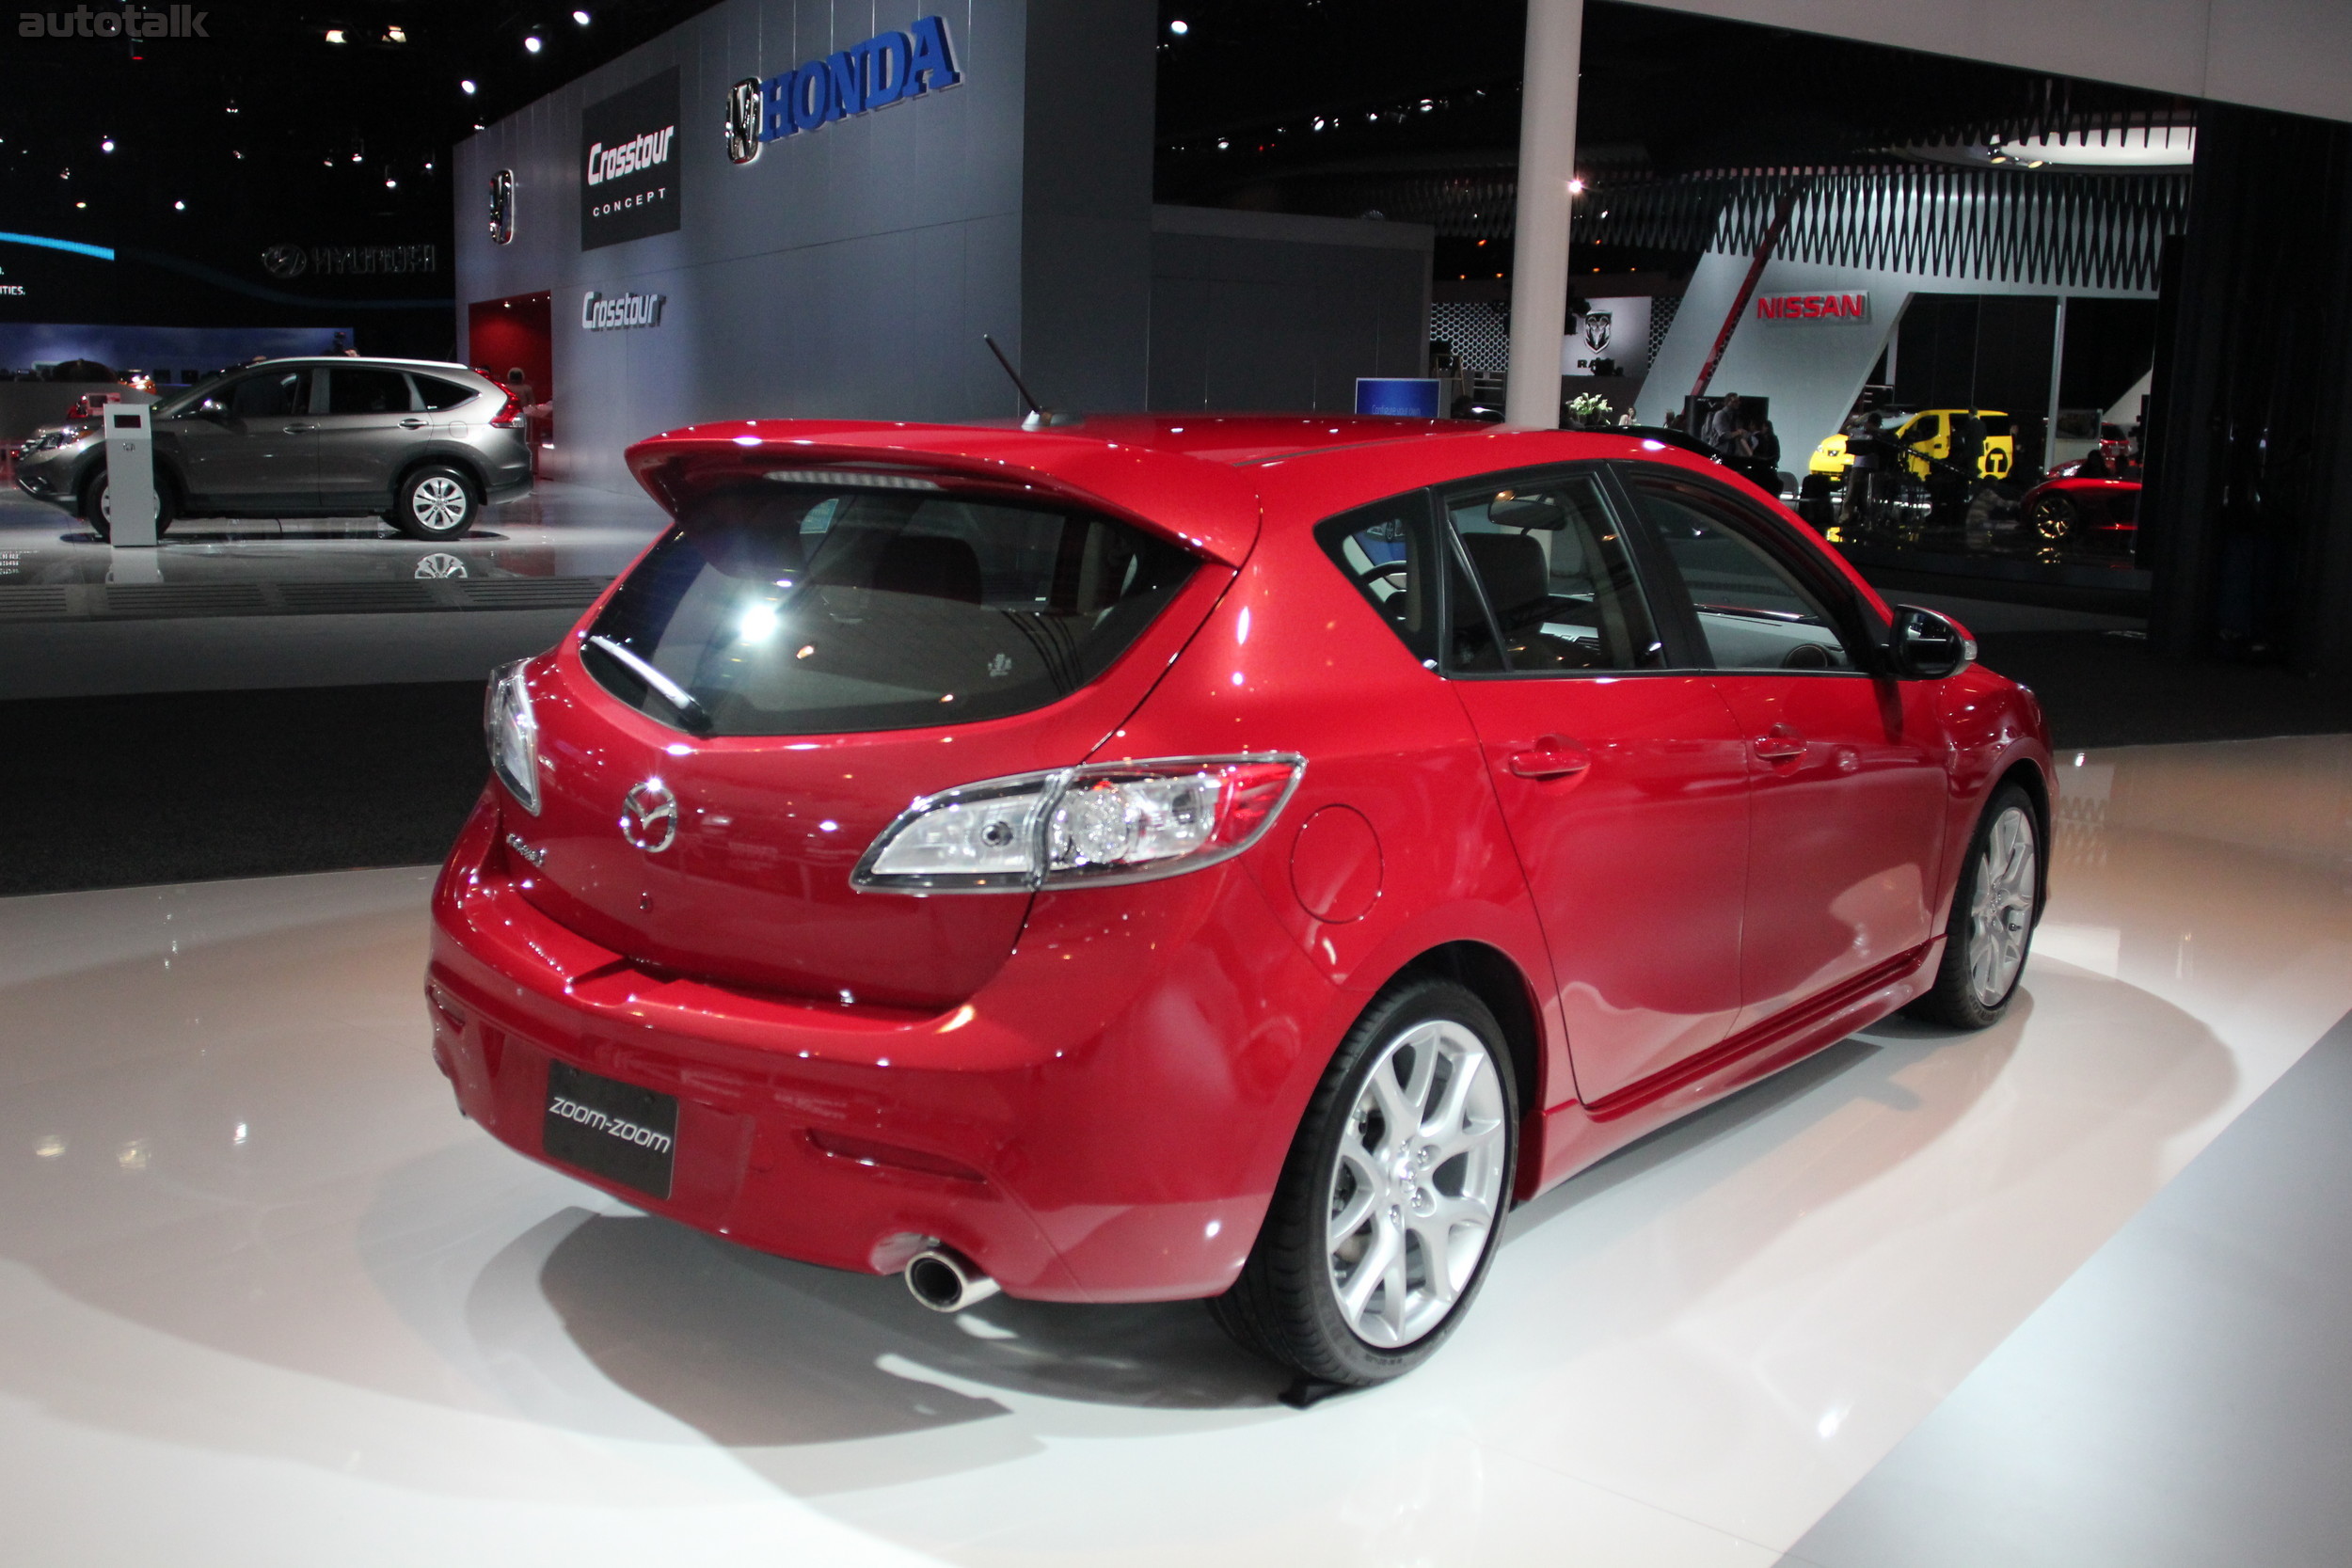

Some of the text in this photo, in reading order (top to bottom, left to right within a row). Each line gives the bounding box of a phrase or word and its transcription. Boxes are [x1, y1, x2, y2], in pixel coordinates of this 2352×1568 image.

[758, 15, 961, 142] HONDA
[587, 124, 675, 185] Crosstour
[592, 187, 666, 217] CONCEPT
[581, 291, 665, 329] Crosstour
[1756, 293, 1864, 319] NISSAN
[548, 1097, 671, 1153] zoom-zoom
